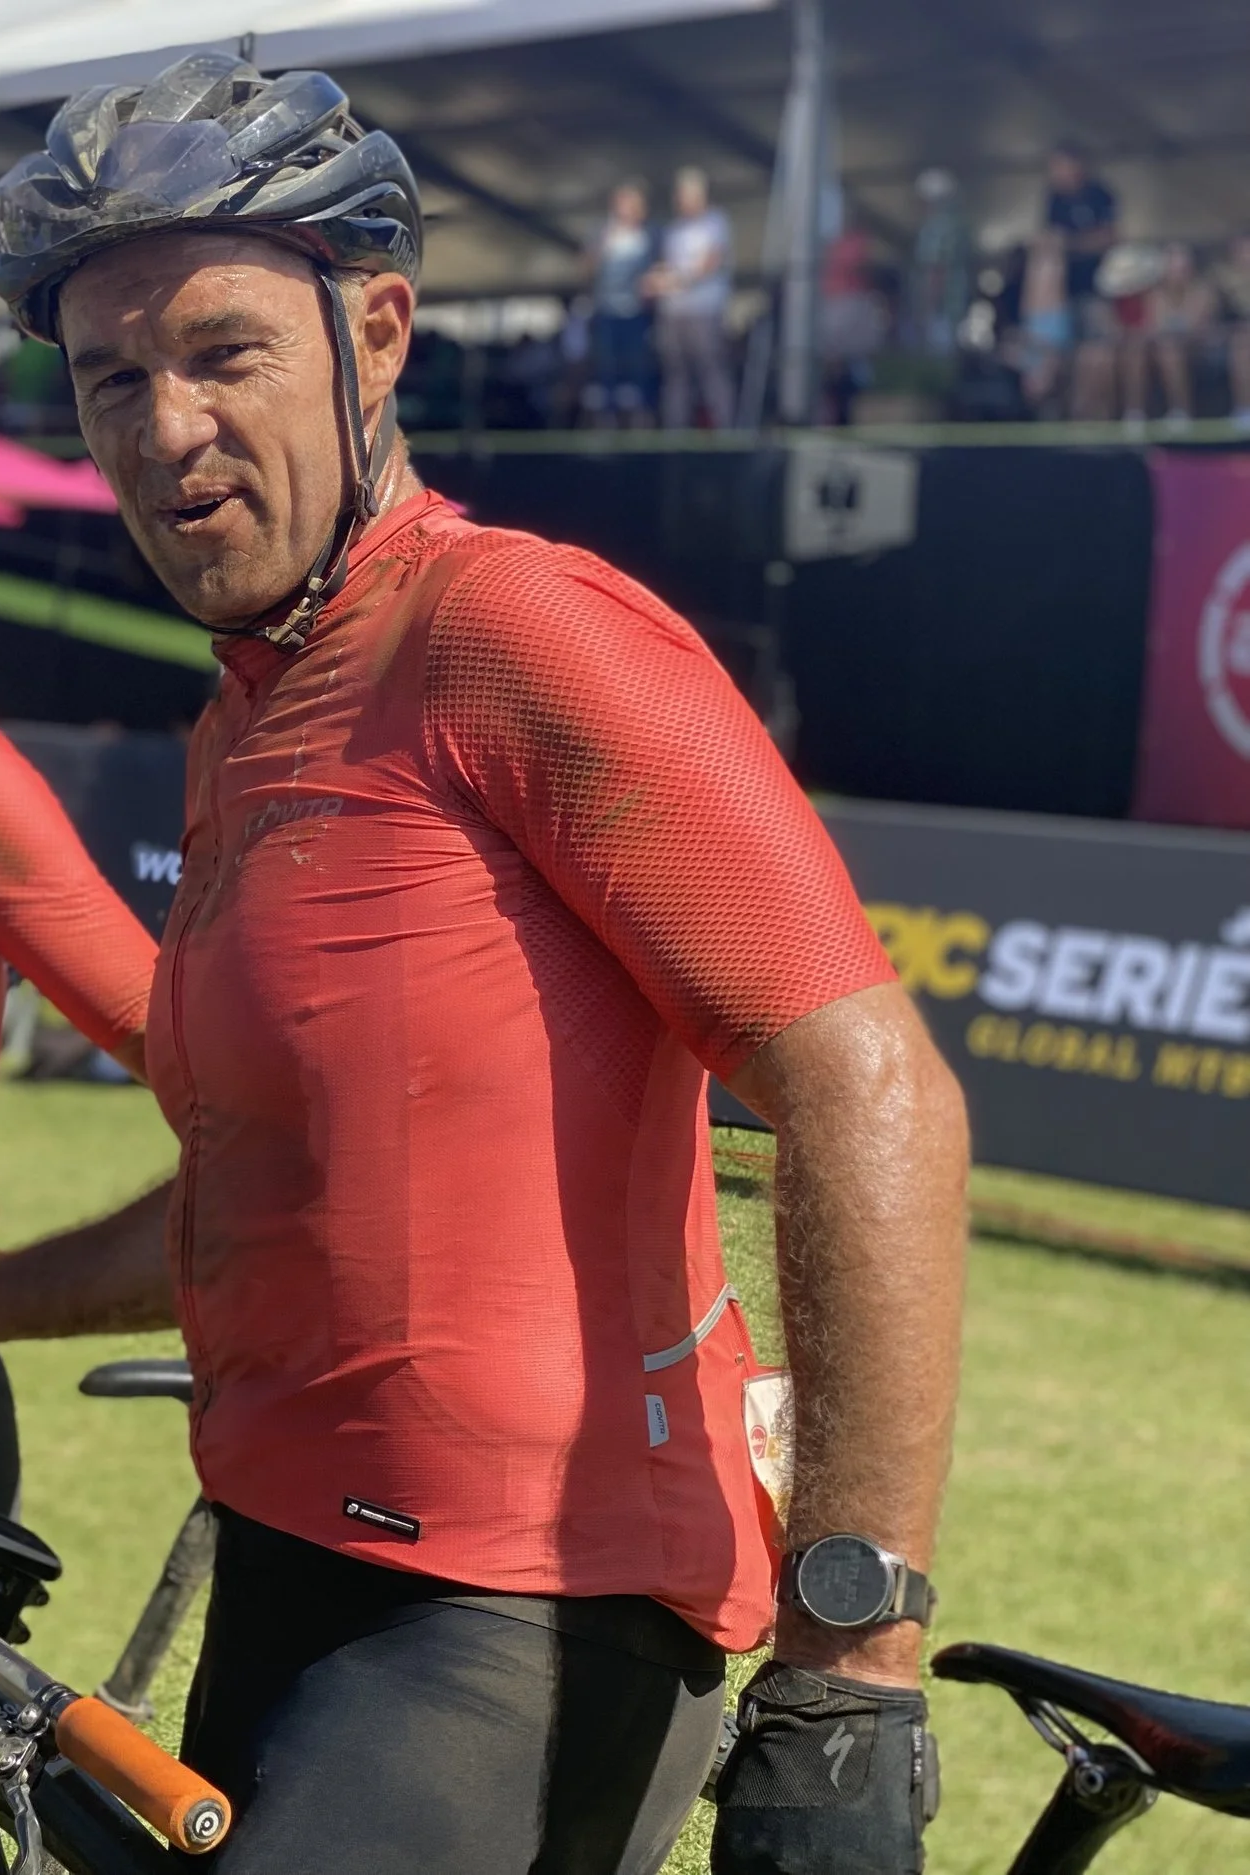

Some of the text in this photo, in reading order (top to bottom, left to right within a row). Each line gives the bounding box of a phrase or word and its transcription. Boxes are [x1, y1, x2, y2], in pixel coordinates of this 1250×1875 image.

[862, 903, 992, 998] PIC
[966, 1015, 1141, 1081] GLOBAL
[914, 1726, 922, 1752] DUAL
